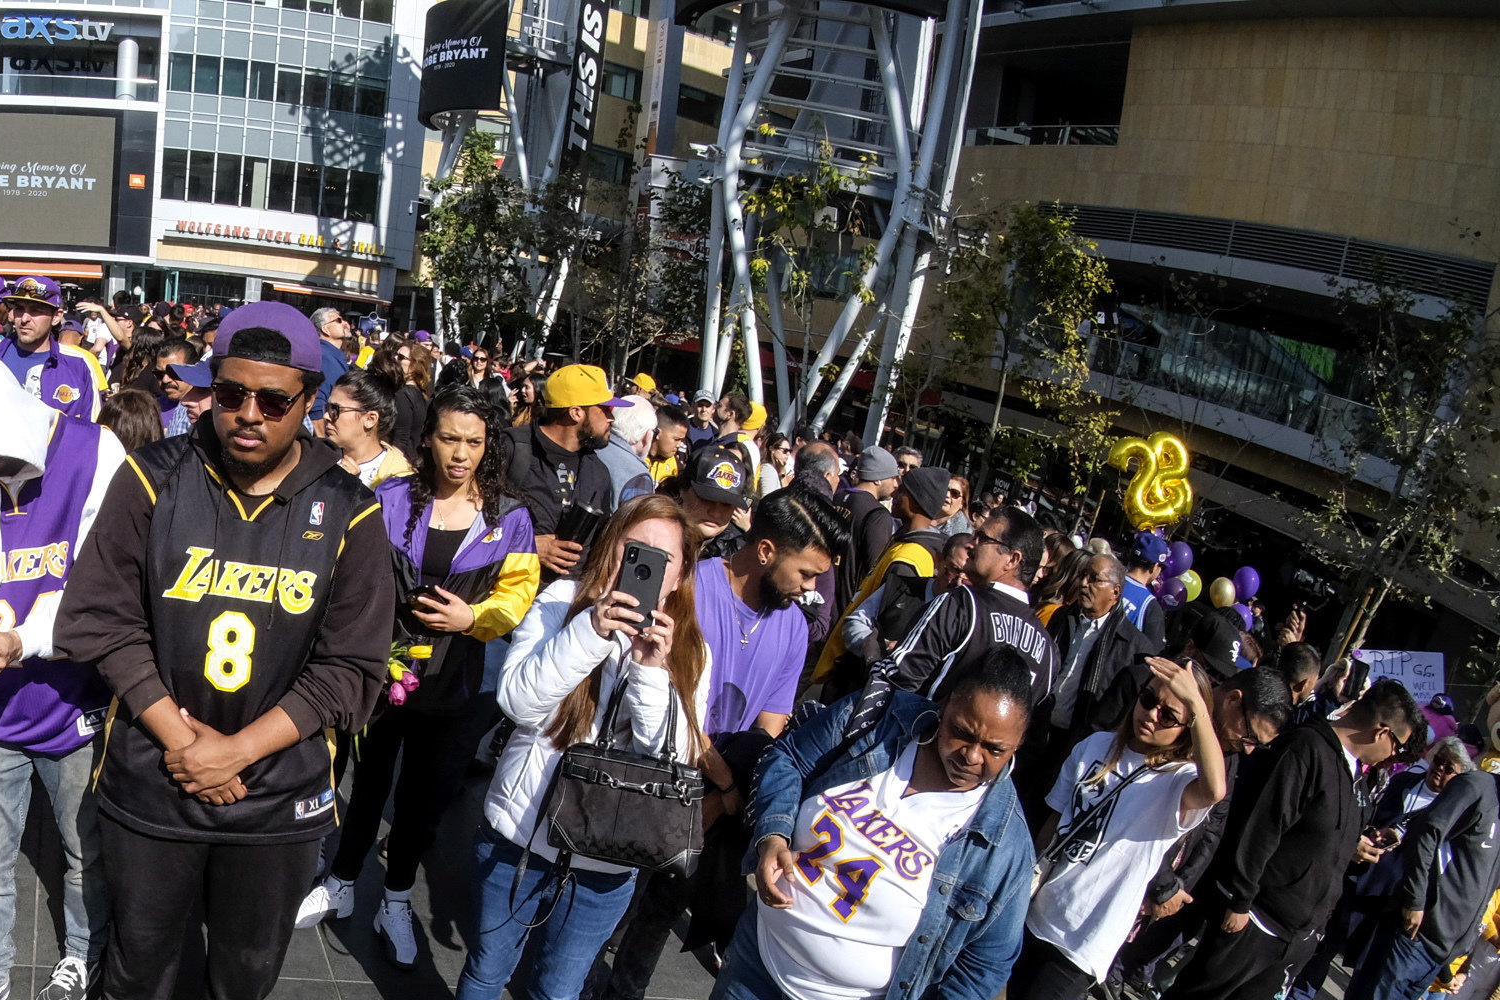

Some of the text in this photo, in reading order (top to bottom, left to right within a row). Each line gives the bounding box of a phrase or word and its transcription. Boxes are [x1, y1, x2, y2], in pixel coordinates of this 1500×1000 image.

[0, 13, 114, 45] axs.tv
[440, 47, 489, 63] BRYANT
[20, 161, 66, 176] Memory
[16, 175, 97, 191] BRYANT
[28, 189, 48, 197] 2020
[177, 220, 251, 239] WOLFGANG
[258, 228, 293, 243] PUCK
[707, 466, 739, 488] LAKERS
[161, 545, 318, 615] LAKERS
[203, 610, 256, 693] 8
[990, 612, 1046, 664] BYNUM
[821, 780, 933, 882] LAKERS
[795, 811, 885, 924] 24
